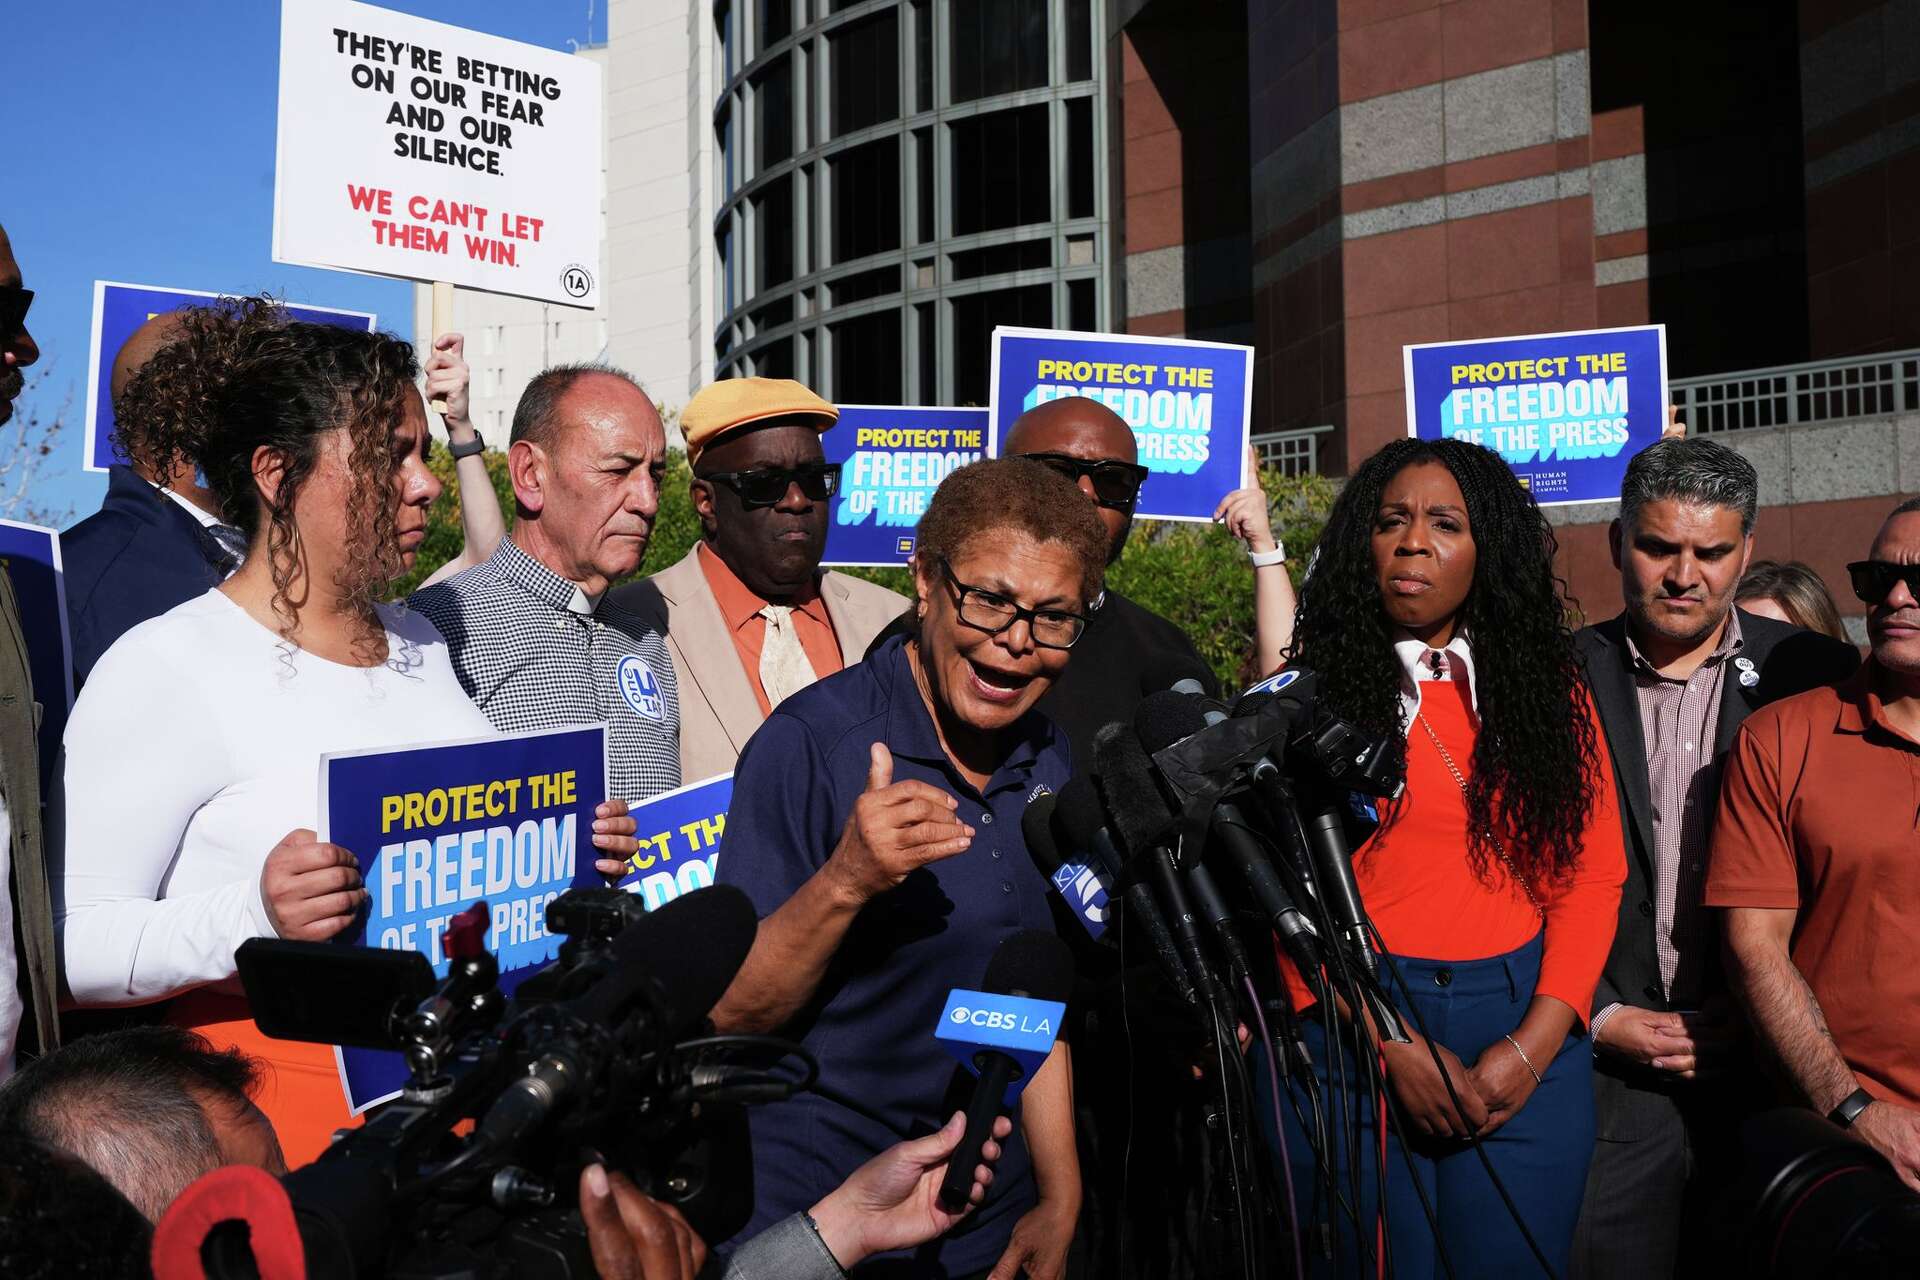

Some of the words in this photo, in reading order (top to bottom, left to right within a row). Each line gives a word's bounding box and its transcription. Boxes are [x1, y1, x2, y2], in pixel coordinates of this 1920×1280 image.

[333, 28, 442, 75] THEY'RE
[457, 56, 562, 101] BETTING
[351, 64, 394, 94] ON
[411, 76, 467, 109] OUR
[482, 91, 544, 127] FEAR
[386, 101, 445, 132] AND
[460, 116, 512, 149] OUR
[394, 133, 504, 176] SILENCE.
[347, 184, 392, 215] WE
[408, 196, 487, 231] CAN'T
[502, 213, 544, 242] LET
[372, 220, 449, 254] THEM
[464, 234, 520, 268] WIN.
[568, 274, 586, 291] 1A
[1037, 359, 1157, 385] PROTECT
[1164, 366, 1213, 388] THE
[1451, 356, 1569, 385] PROTECT
[1576, 352, 1627, 374] THE
[1452, 376, 1629, 425] FREEDOM
[856, 428, 949, 448] PROTECT
[953, 430, 981, 448] THE
[1493, 424, 1540, 452] THE
[1551, 418, 1630, 447] PRESS
[1535, 471, 1567, 479] HUMAN
[1535, 479, 1567, 487] RIGHTS
[849, 490, 878, 514] OF
[885, 490, 926, 515] THE
[382, 778, 521, 833] PROTECT
[527, 770, 577, 809] THE
[680, 813, 727, 852] TH
[381, 813, 577, 919] FREEDOM
[491, 888, 572, 951] PRE
[970, 1009, 1017, 1030] CBS
[1020, 1017, 1051, 1036] LA
